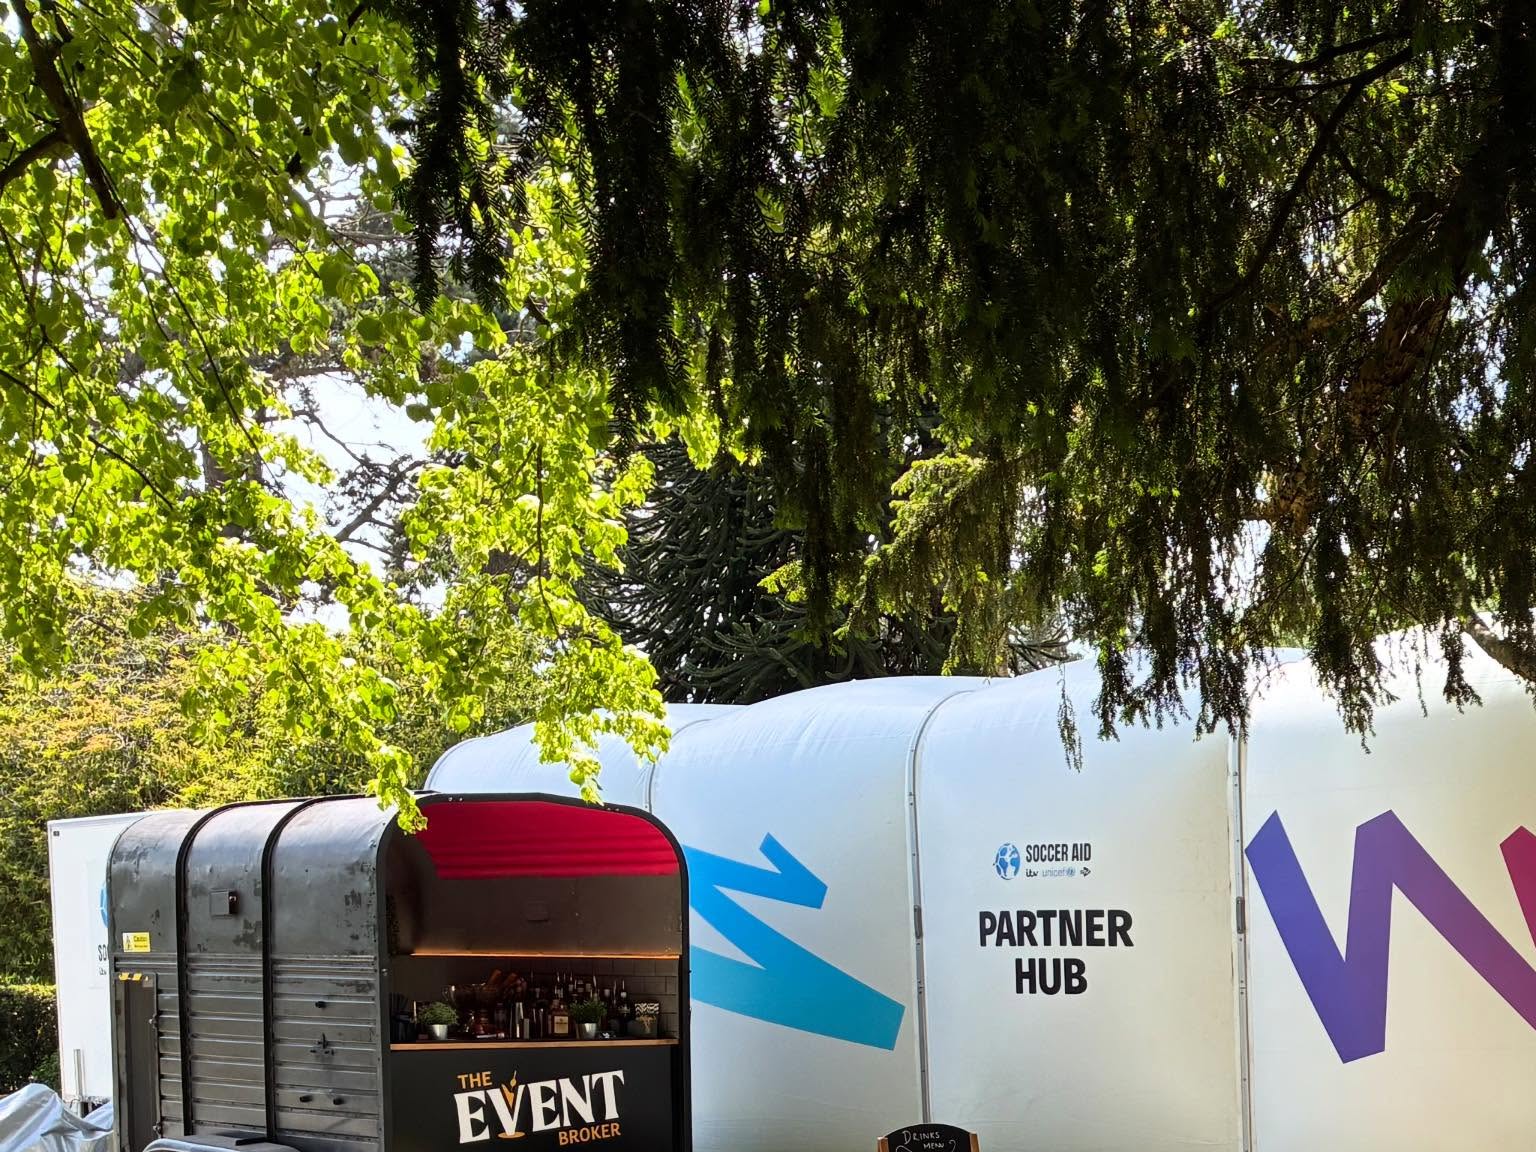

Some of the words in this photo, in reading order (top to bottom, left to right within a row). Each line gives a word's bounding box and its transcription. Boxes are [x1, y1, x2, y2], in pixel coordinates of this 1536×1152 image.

[1025, 843, 1069, 863] SOCCER
[1071, 842, 1092, 862] AID
[1025, 868, 1039, 878] itv
[978, 909, 1135, 947] PARTNER
[1015, 957, 1089, 995] HUB
[457, 1071, 492, 1090] THE
[453, 1070, 625, 1144] EVENT
[558, 1122, 621, 1146] BROKER
[903, 1130, 940, 1145] DRINKS
[923, 1142, 945, 1150] MENU
